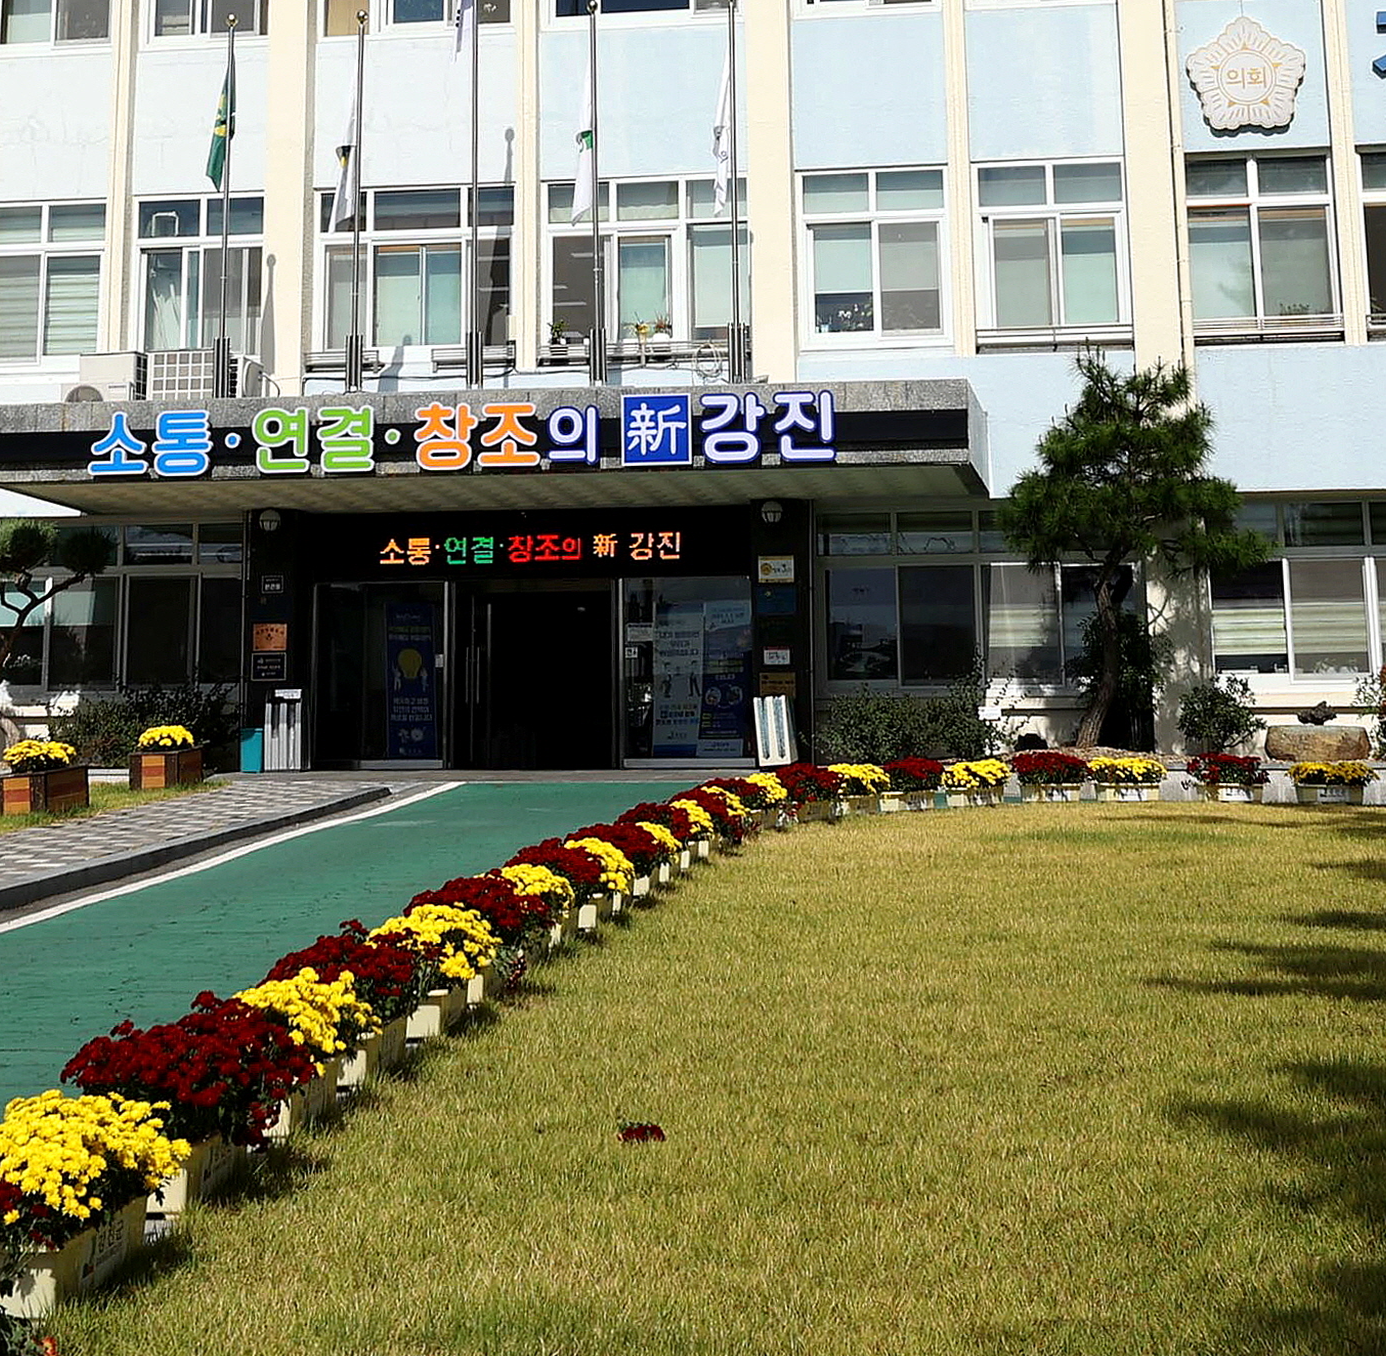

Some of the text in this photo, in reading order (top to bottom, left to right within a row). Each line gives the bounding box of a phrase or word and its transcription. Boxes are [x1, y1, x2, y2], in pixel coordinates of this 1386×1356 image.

[1226, 66, 1267, 90] 의회
[88, 390, 836, 476] 소통·연결·창조의 新 강진
[379, 531, 681, 566] 소통·연결·창조의 新 강진
